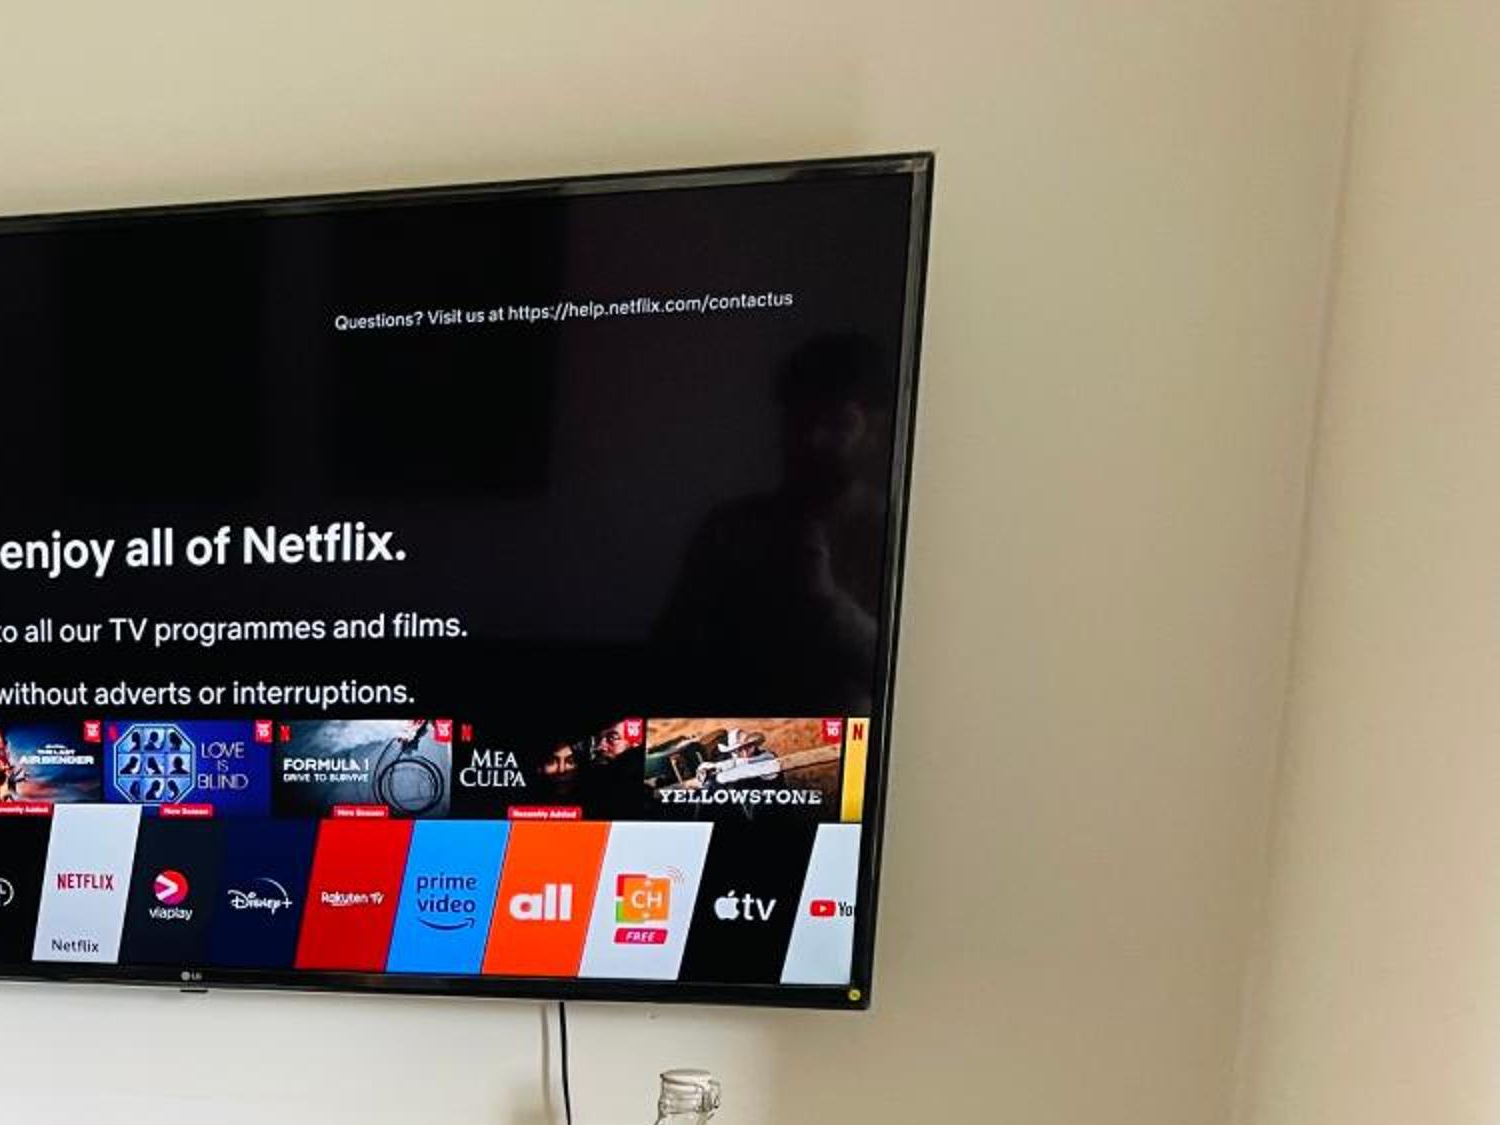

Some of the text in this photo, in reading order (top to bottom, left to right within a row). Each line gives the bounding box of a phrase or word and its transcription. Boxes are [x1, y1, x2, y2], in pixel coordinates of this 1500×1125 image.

[334, 292, 794, 332] Questions? Visit us at https://help.netflix.com/contactus
[0, 529, 116, 579] enjoy
[125, 527, 173, 568] all
[185, 525, 231, 566] of
[243, 521, 407, 564] Netflix.
[24, 618, 53, 643] all
[59, 623, 103, 643] our
[108, 617, 148, 641] TV
[155, 620, 326, 647] programmes
[333, 612, 385, 639] and
[392, 612, 468, 639] films.
[94, 681, 192, 705] adverts
[198, 686, 226, 705] or
[233, 679, 415, 710] interruptions.
[853, 723, 863, 741] N
[201, 741, 245, 759] LOVE
[470, 749, 519, 769] MEA
[19, 755, 95, 765] AIRBENDER
[217, 761, 228, 771] IS
[283, 758, 369, 771] FORMULA 1
[197, 773, 249, 790] BLIND
[283, 773, 369, 783] DRIVE TO SURVIVE
[459, 767, 527, 788] CULPA
[659, 789, 822, 805] YELLOWSTONE
[57, 873, 115, 891] NETFLIX
[416, 873, 477, 892] prime
[321, 890, 369, 906] Rakuten
[418, 896, 476, 913] video
[509, 883, 573, 921] all
[631, 890, 663, 909] CH
[742, 893, 777, 921] tv
[149, 907, 194, 921] viaplay
[625, 931, 656, 942] FREE
[51, 939, 99, 953] Netflix
